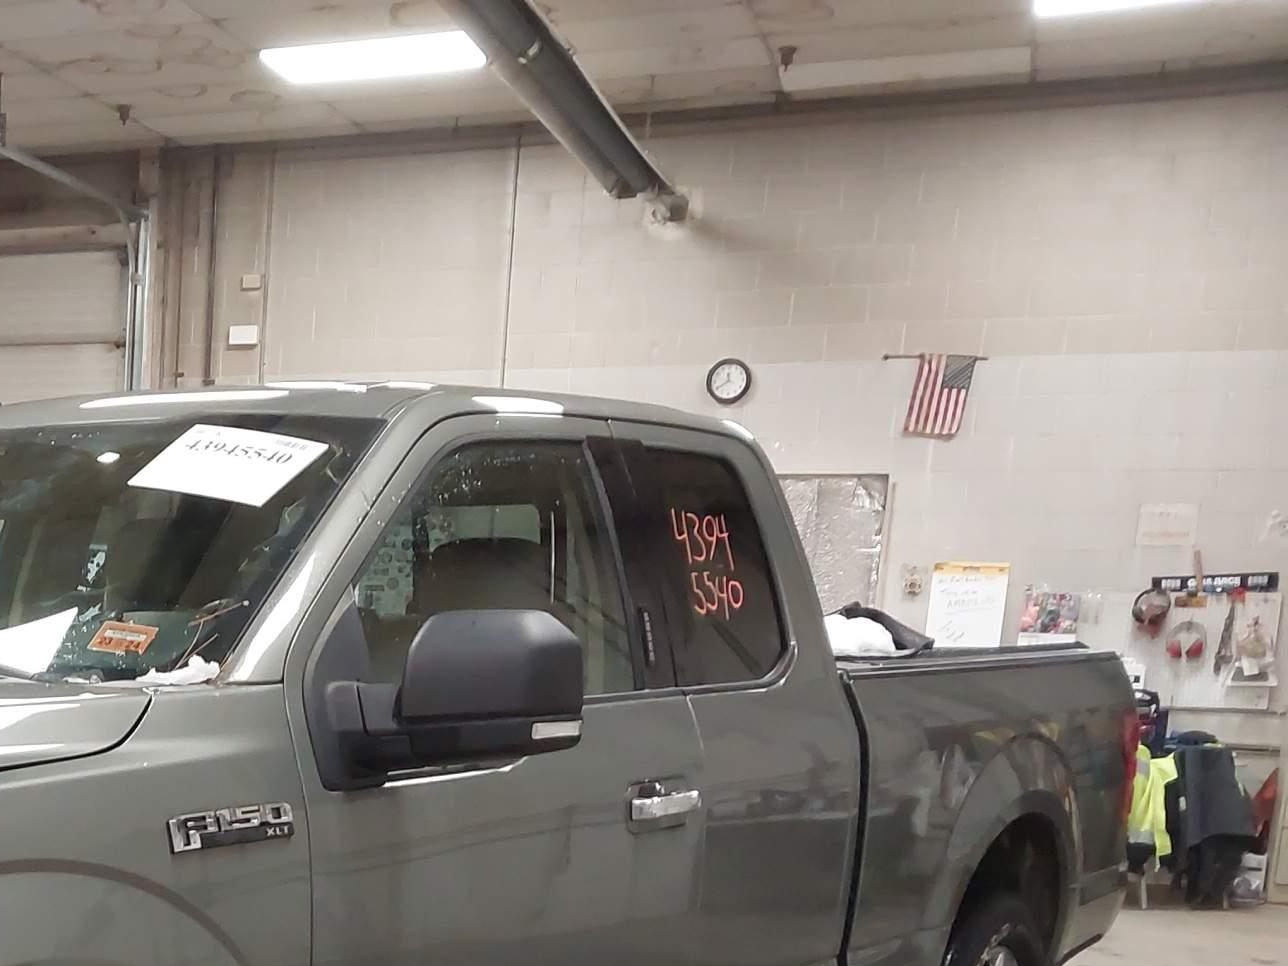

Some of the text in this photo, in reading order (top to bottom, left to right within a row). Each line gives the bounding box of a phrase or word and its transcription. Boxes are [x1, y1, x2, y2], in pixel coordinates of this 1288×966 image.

[185, 439, 293, 465] 43945540
[671, 507, 735, 572] 4394
[691, 571, 743, 621] 5540
[266, 825, 289, 837] XLT
